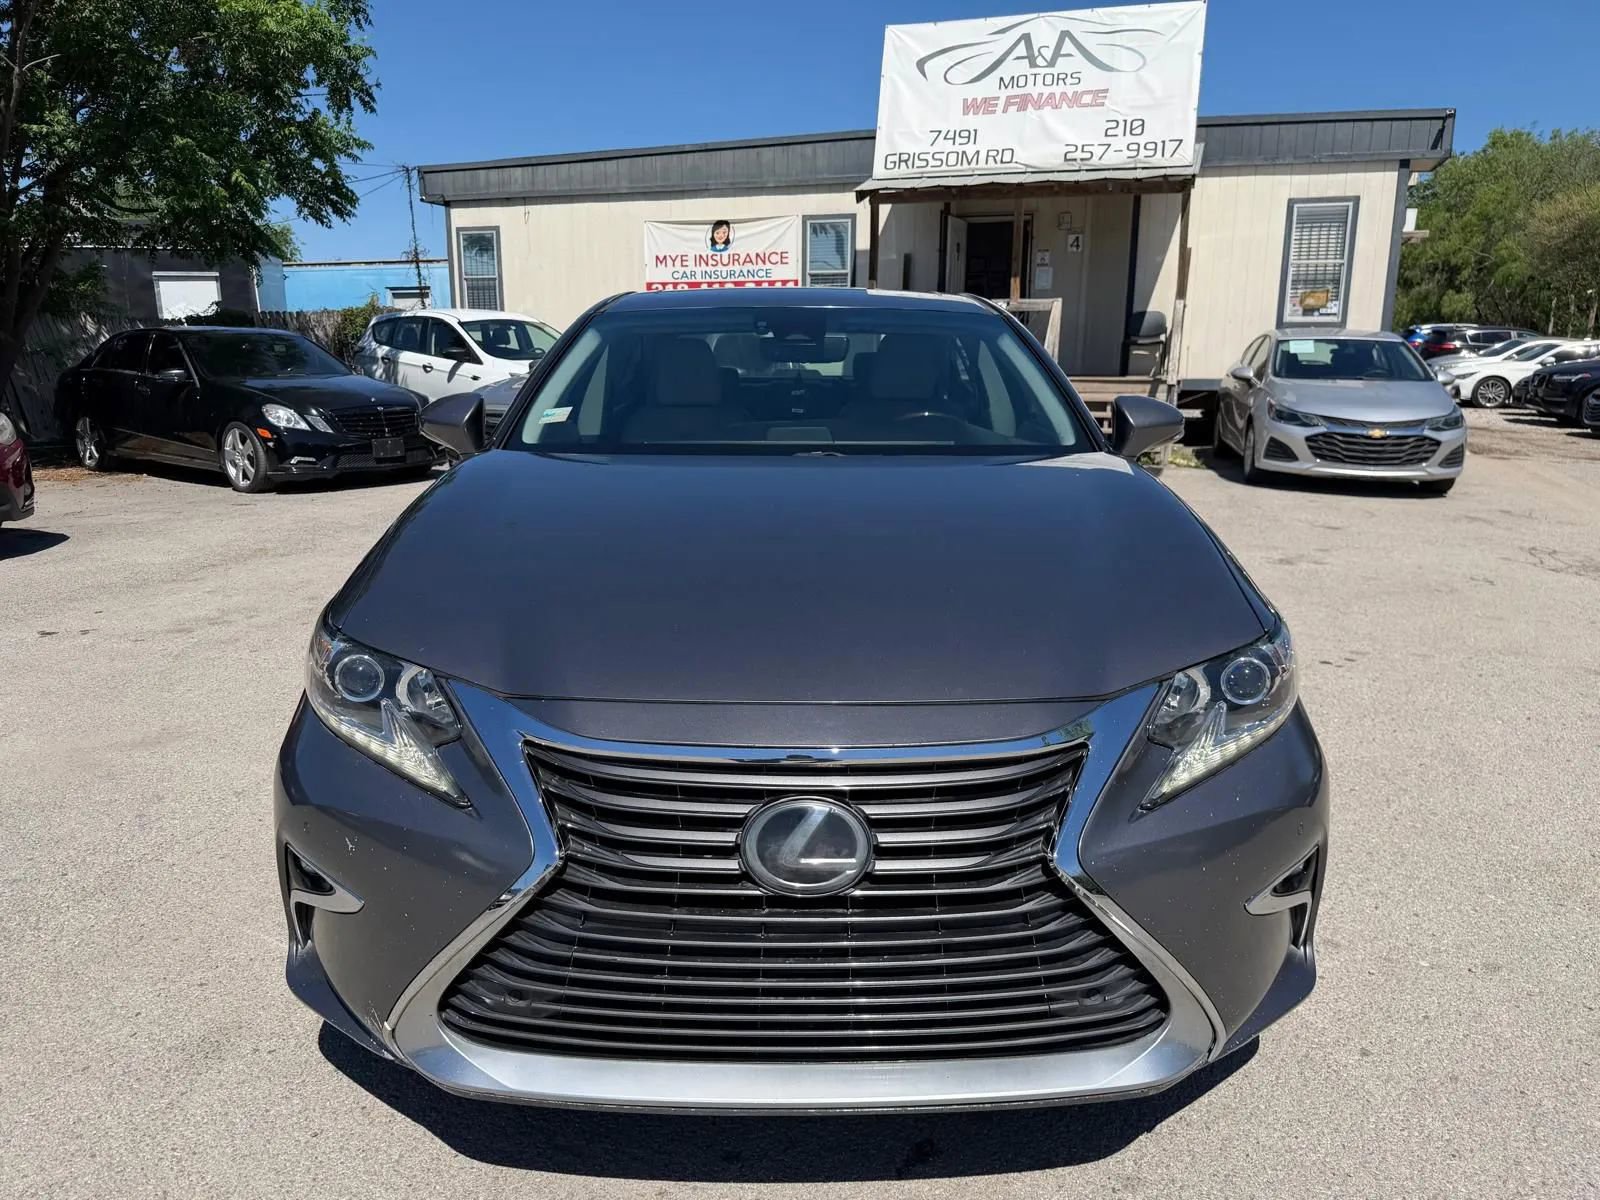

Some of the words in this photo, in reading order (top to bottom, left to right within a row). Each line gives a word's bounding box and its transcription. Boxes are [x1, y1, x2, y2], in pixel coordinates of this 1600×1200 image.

[964, 29, 1118, 84] A&A
[998, 71, 1082, 91] MOTORS
[962, 96, 1000, 116] WE
[1002, 88, 1109, 114] FINANCE
[929, 128, 978, 147] 7491
[1104, 118, 1145, 138] 210
[884, 150, 980, 170] GRISSOM
[1063, 138, 1184, 162] 257-9917
[1070, 235, 1080, 251] 4
[655, 254, 689, 267] MYE
[693, 251, 789, 267] INSURANCE
[671, 270, 697, 280] CAR
[700, 268, 772, 280] INSURANCE
